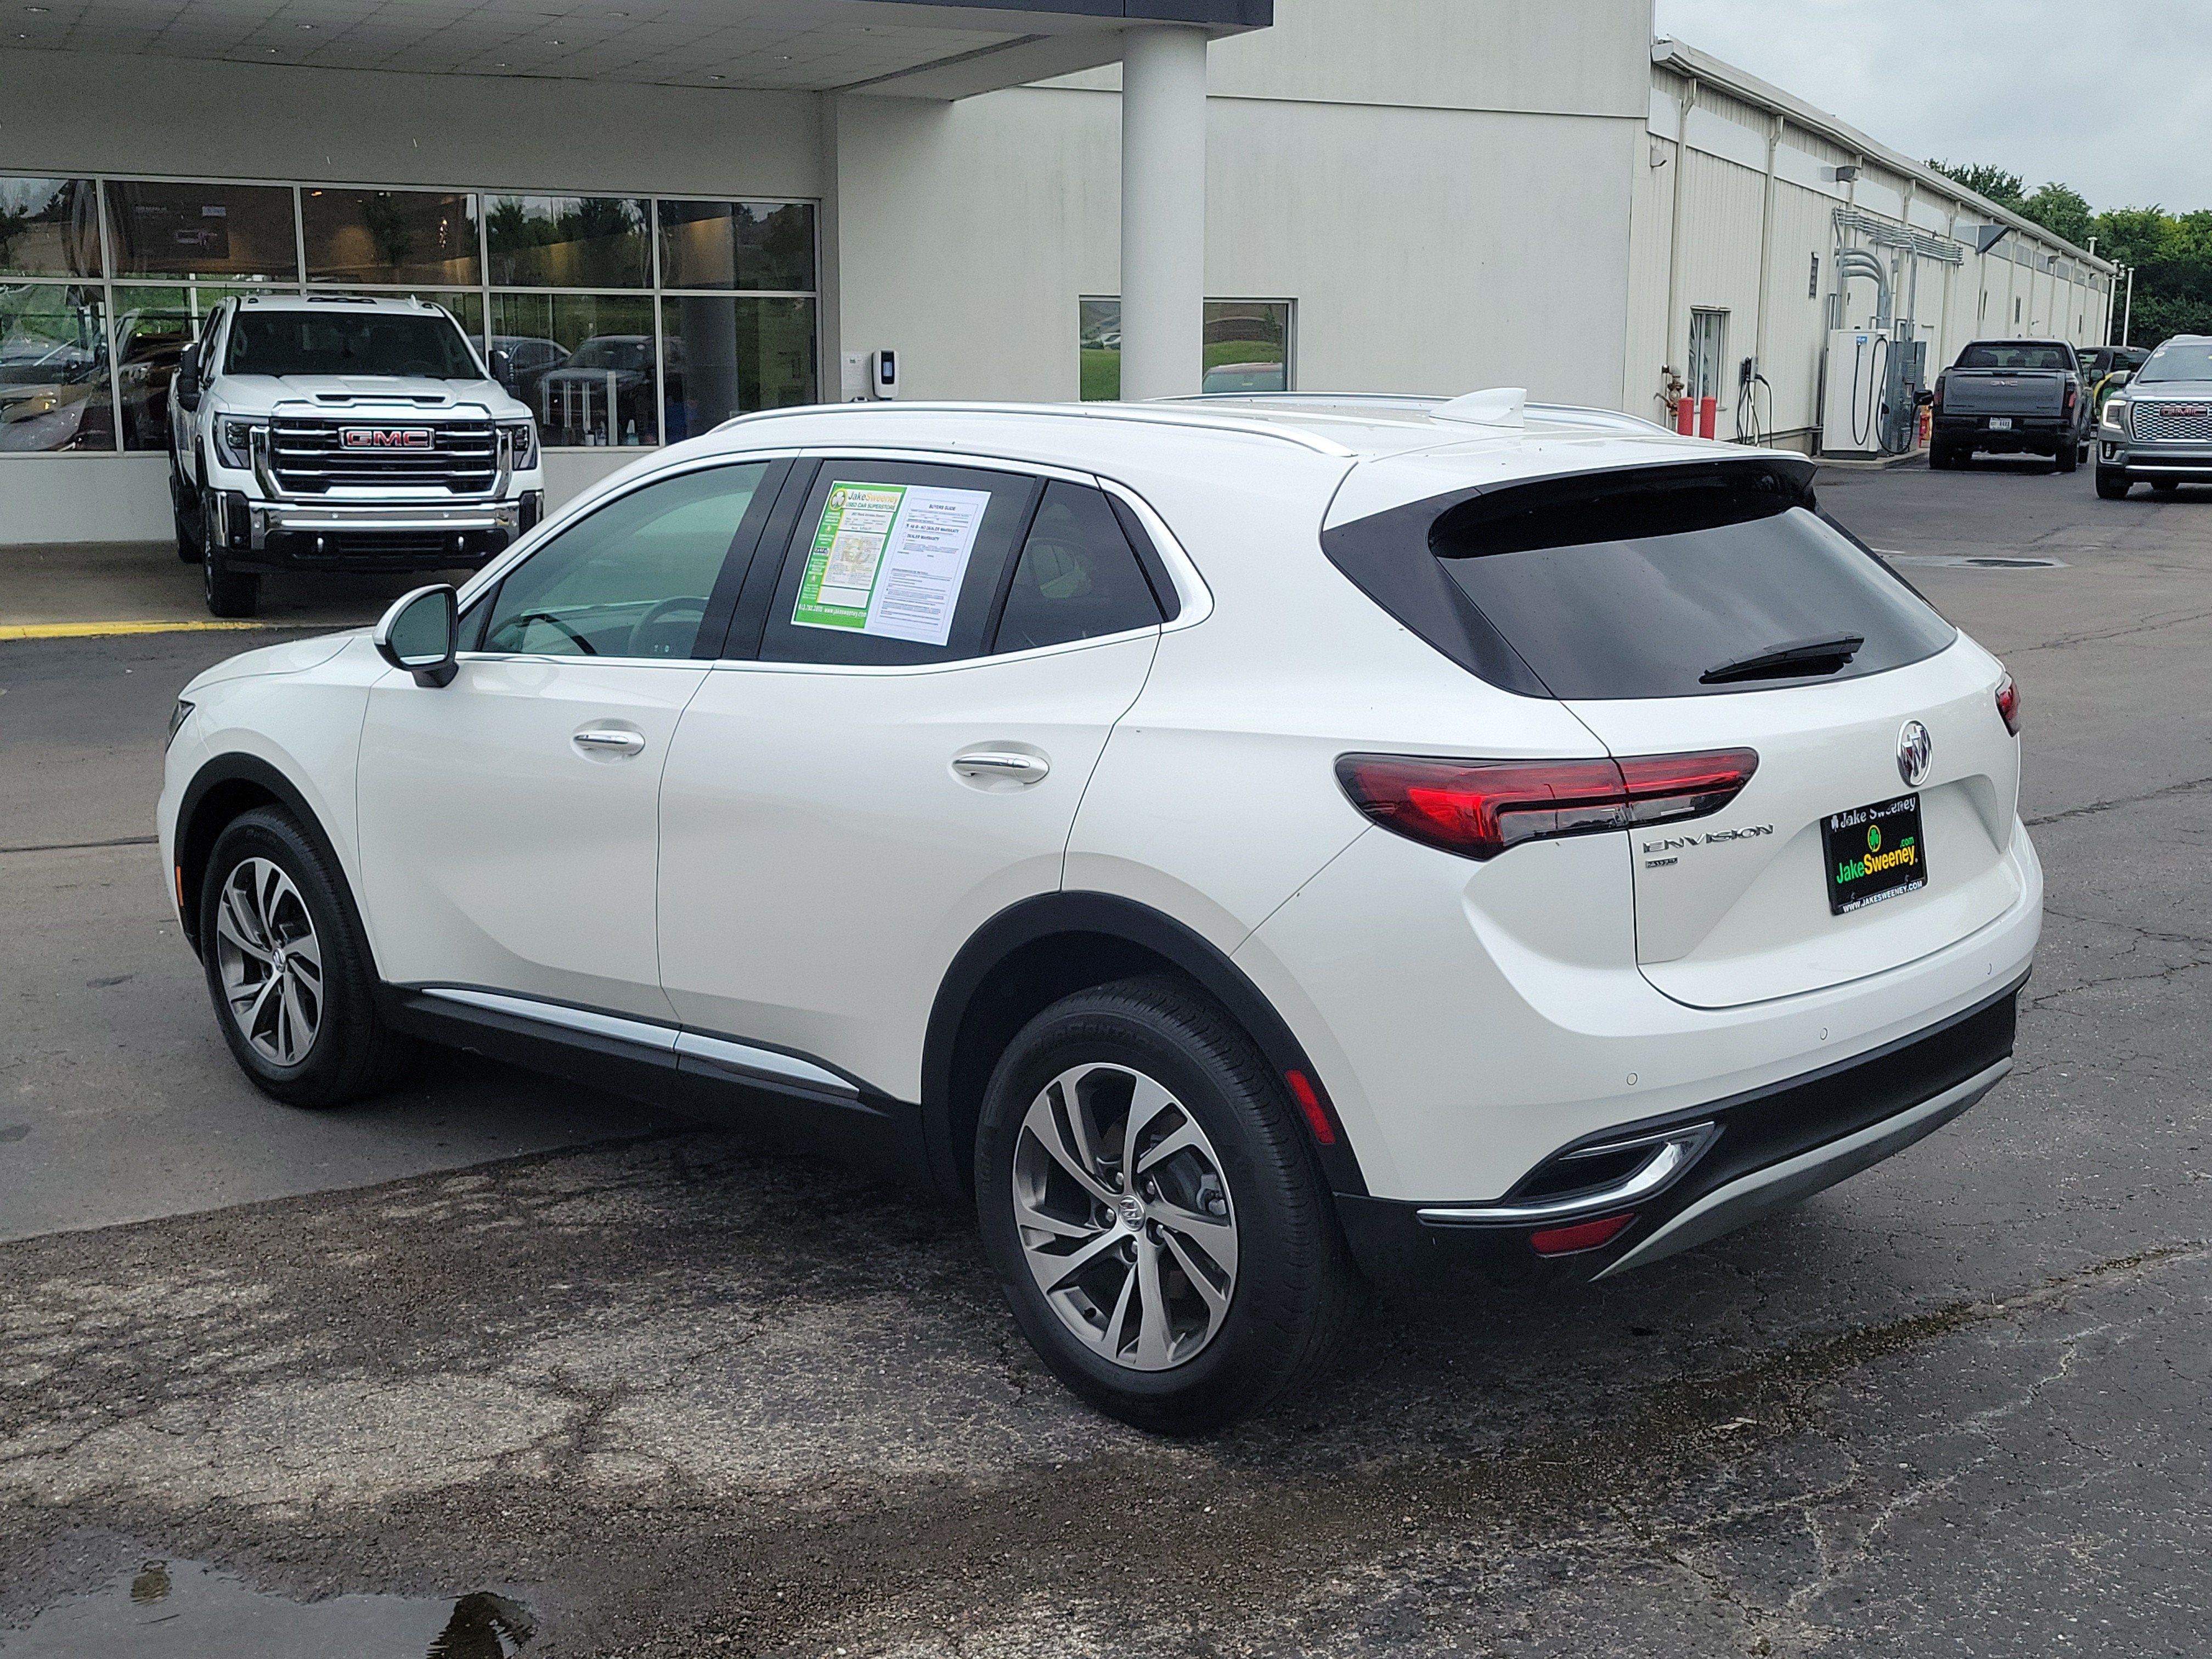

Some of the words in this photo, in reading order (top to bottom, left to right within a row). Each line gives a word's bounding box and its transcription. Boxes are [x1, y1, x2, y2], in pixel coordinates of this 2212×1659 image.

[2161, 408, 2207, 416] GMC
[346, 431, 428, 446] GMC
[1841, 809, 1866, 828] Jake
[1643, 823, 1774, 853] ENVISION
[1900, 837, 1914, 848] .com
[1646, 857, 1678, 868] AWD
[1837, 845, 1915, 884] JakeSweeney
[1843, 881, 1922, 913] WWW.JAKESWEENEY.COM
